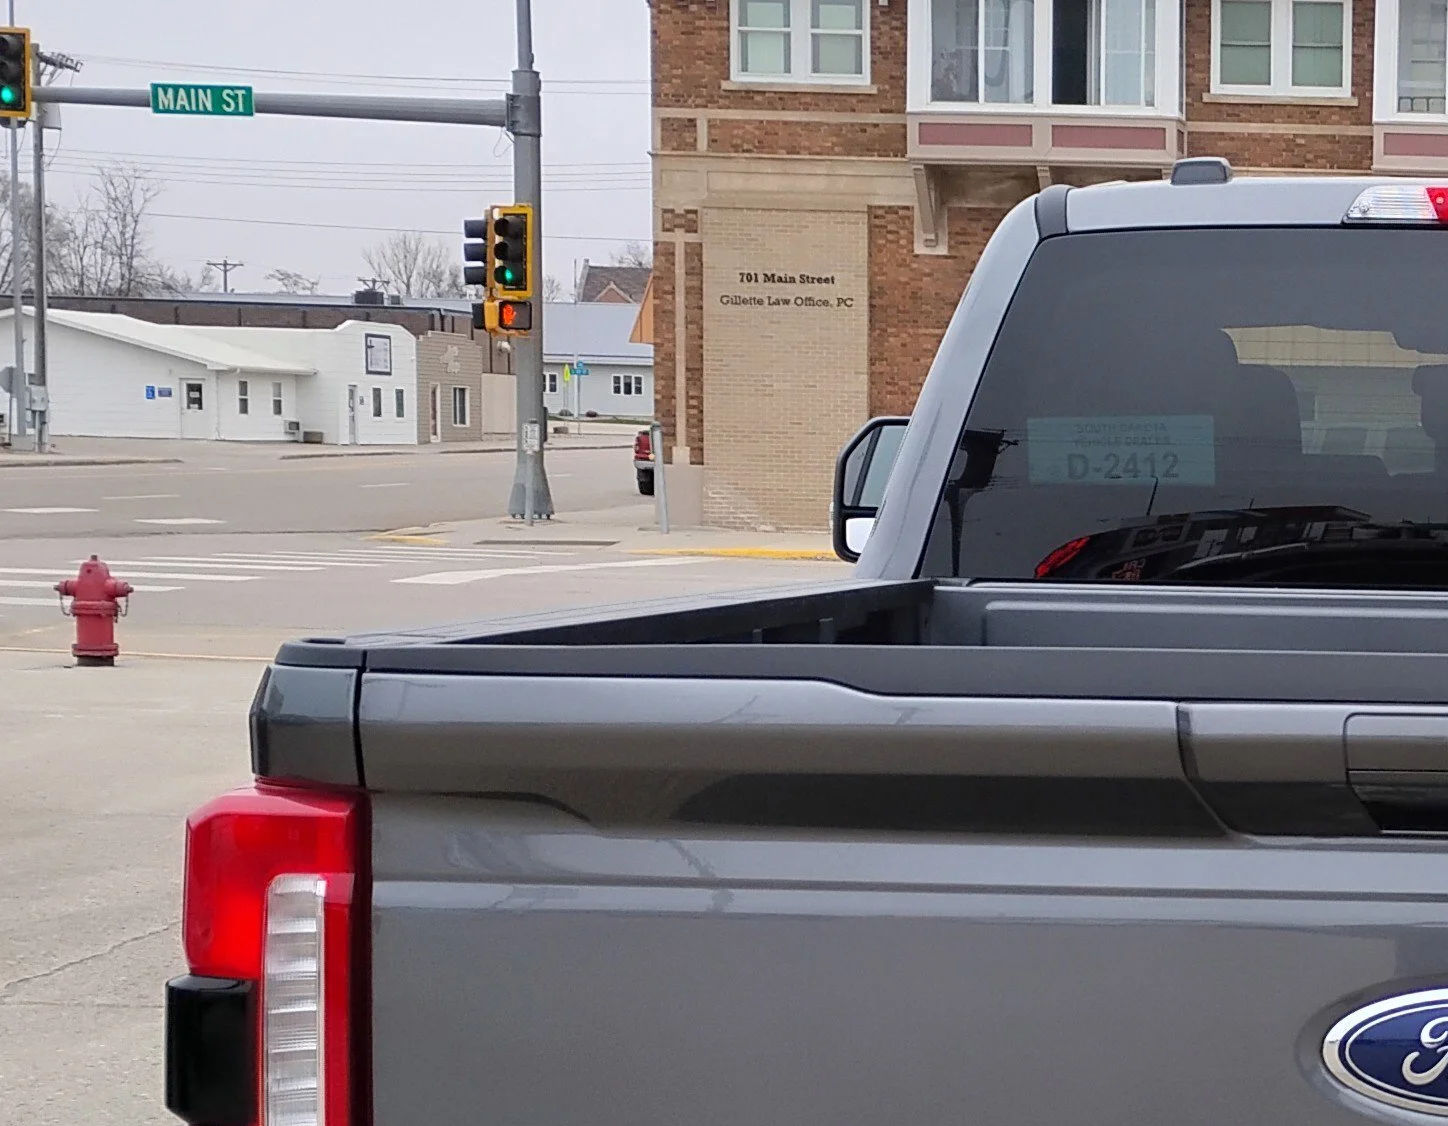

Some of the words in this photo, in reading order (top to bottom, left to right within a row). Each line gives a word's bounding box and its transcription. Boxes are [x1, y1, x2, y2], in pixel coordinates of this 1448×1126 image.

[157, 86, 213, 112] MAIN
[221, 88, 246, 113] ST
[738, 272, 759, 284] 701
[762, 273, 796, 284] Main
[799, 274, 835, 285] Street
[719, 294, 764, 307] Gillette
[767, 295, 791, 307] Law
[836, 297, 854, 308] PC
[1073, 423, 1117, 434] SOUTH
[1066, 452, 1180, 480] D-2412
